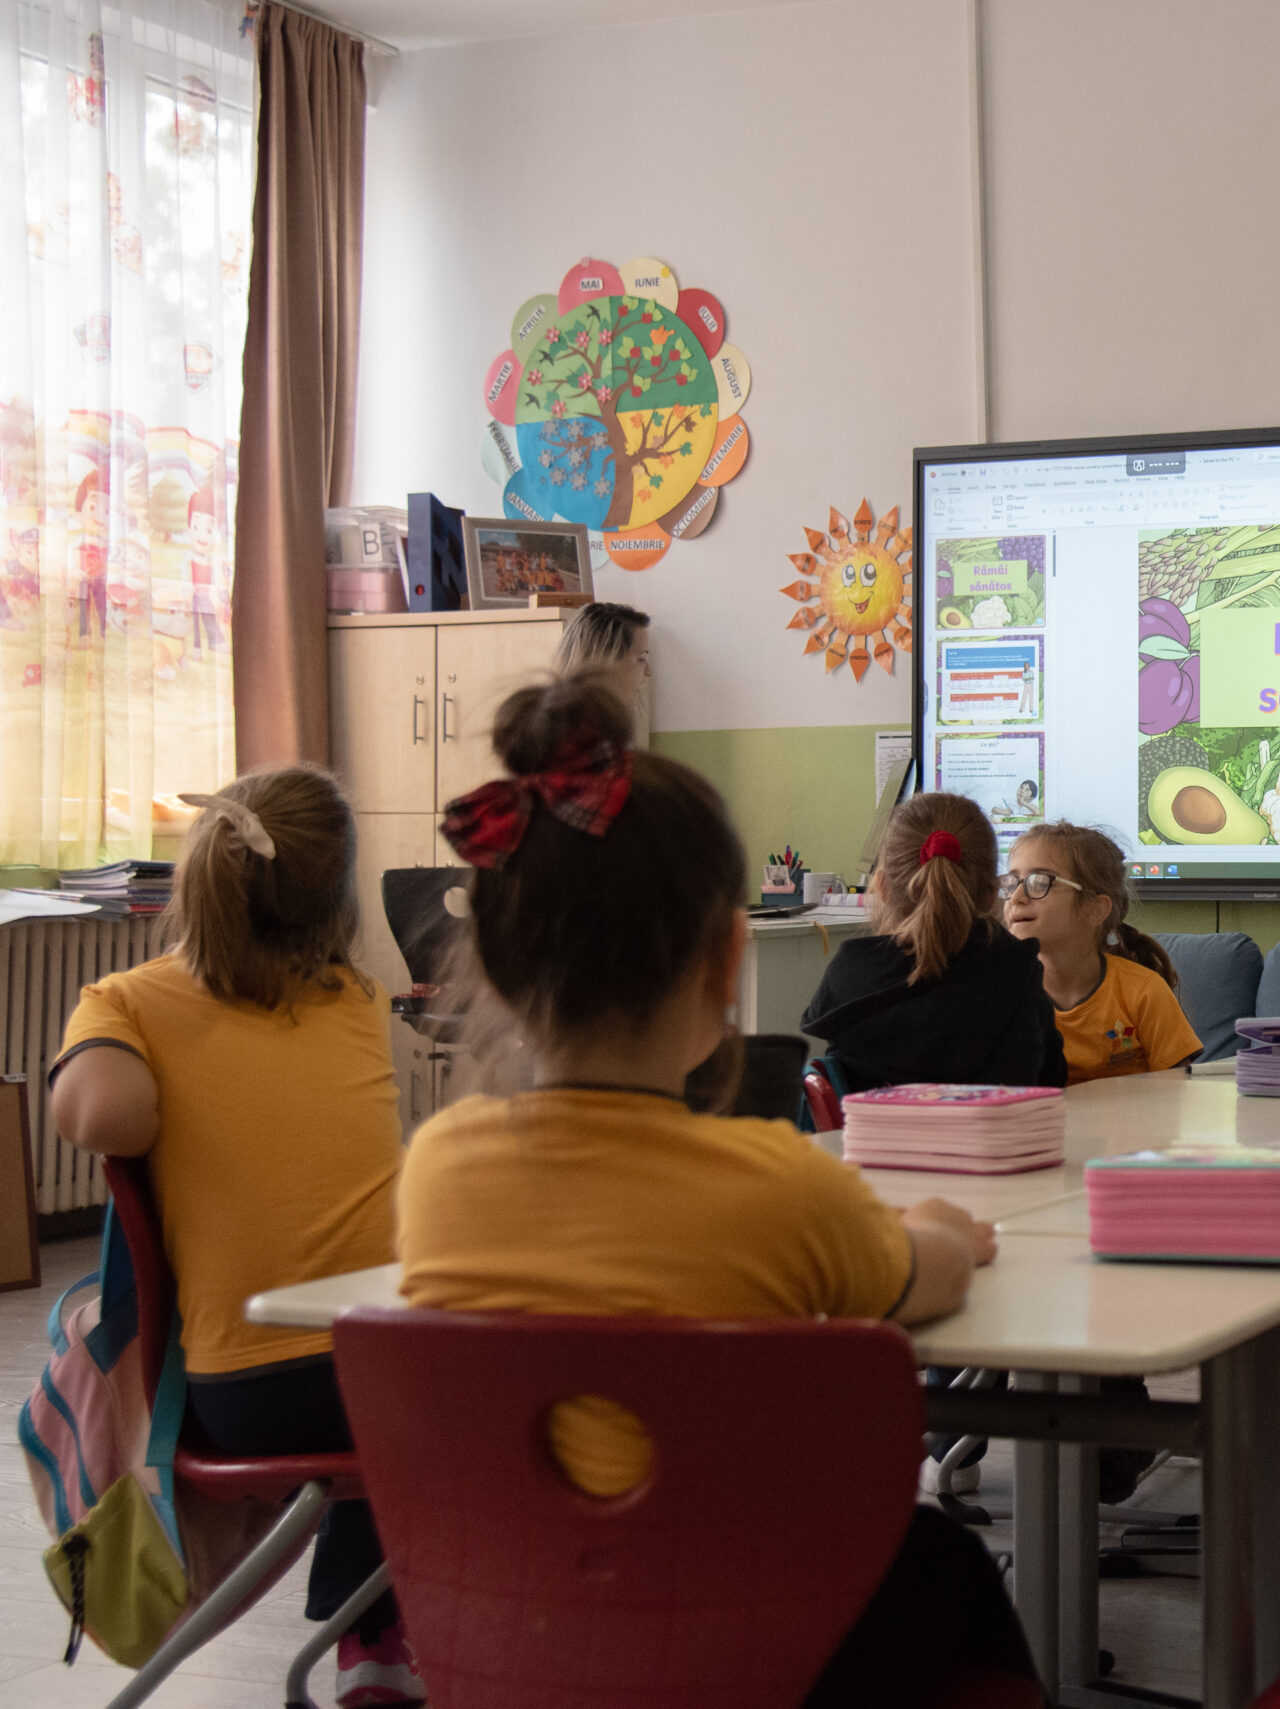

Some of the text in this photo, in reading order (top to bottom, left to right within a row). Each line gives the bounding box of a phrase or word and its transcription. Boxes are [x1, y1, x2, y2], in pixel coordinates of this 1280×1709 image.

[580, 279, 601, 290] MAI
[634, 277, 661, 288] IUNIE
[518, 306, 545, 342] APRILIE
[699, 306, 718, 332] IULIE
[489, 363, 512, 403] MARTIE
[721, 357, 742, 400] AUGUST
[488, 423, 520, 473] FEBRUARIE
[700, 424, 745, 481] SEPTEMBRIE
[507, 492, 544, 522] IANUAR
[672, 487, 716, 538] OCTOMBRIE
[363, 530, 380, 555] B
[610, 539, 665, 550] NOIEMBRIE
[973, 564, 1009, 576] Rămâi
[969, 581, 1012, 592] sănătos
